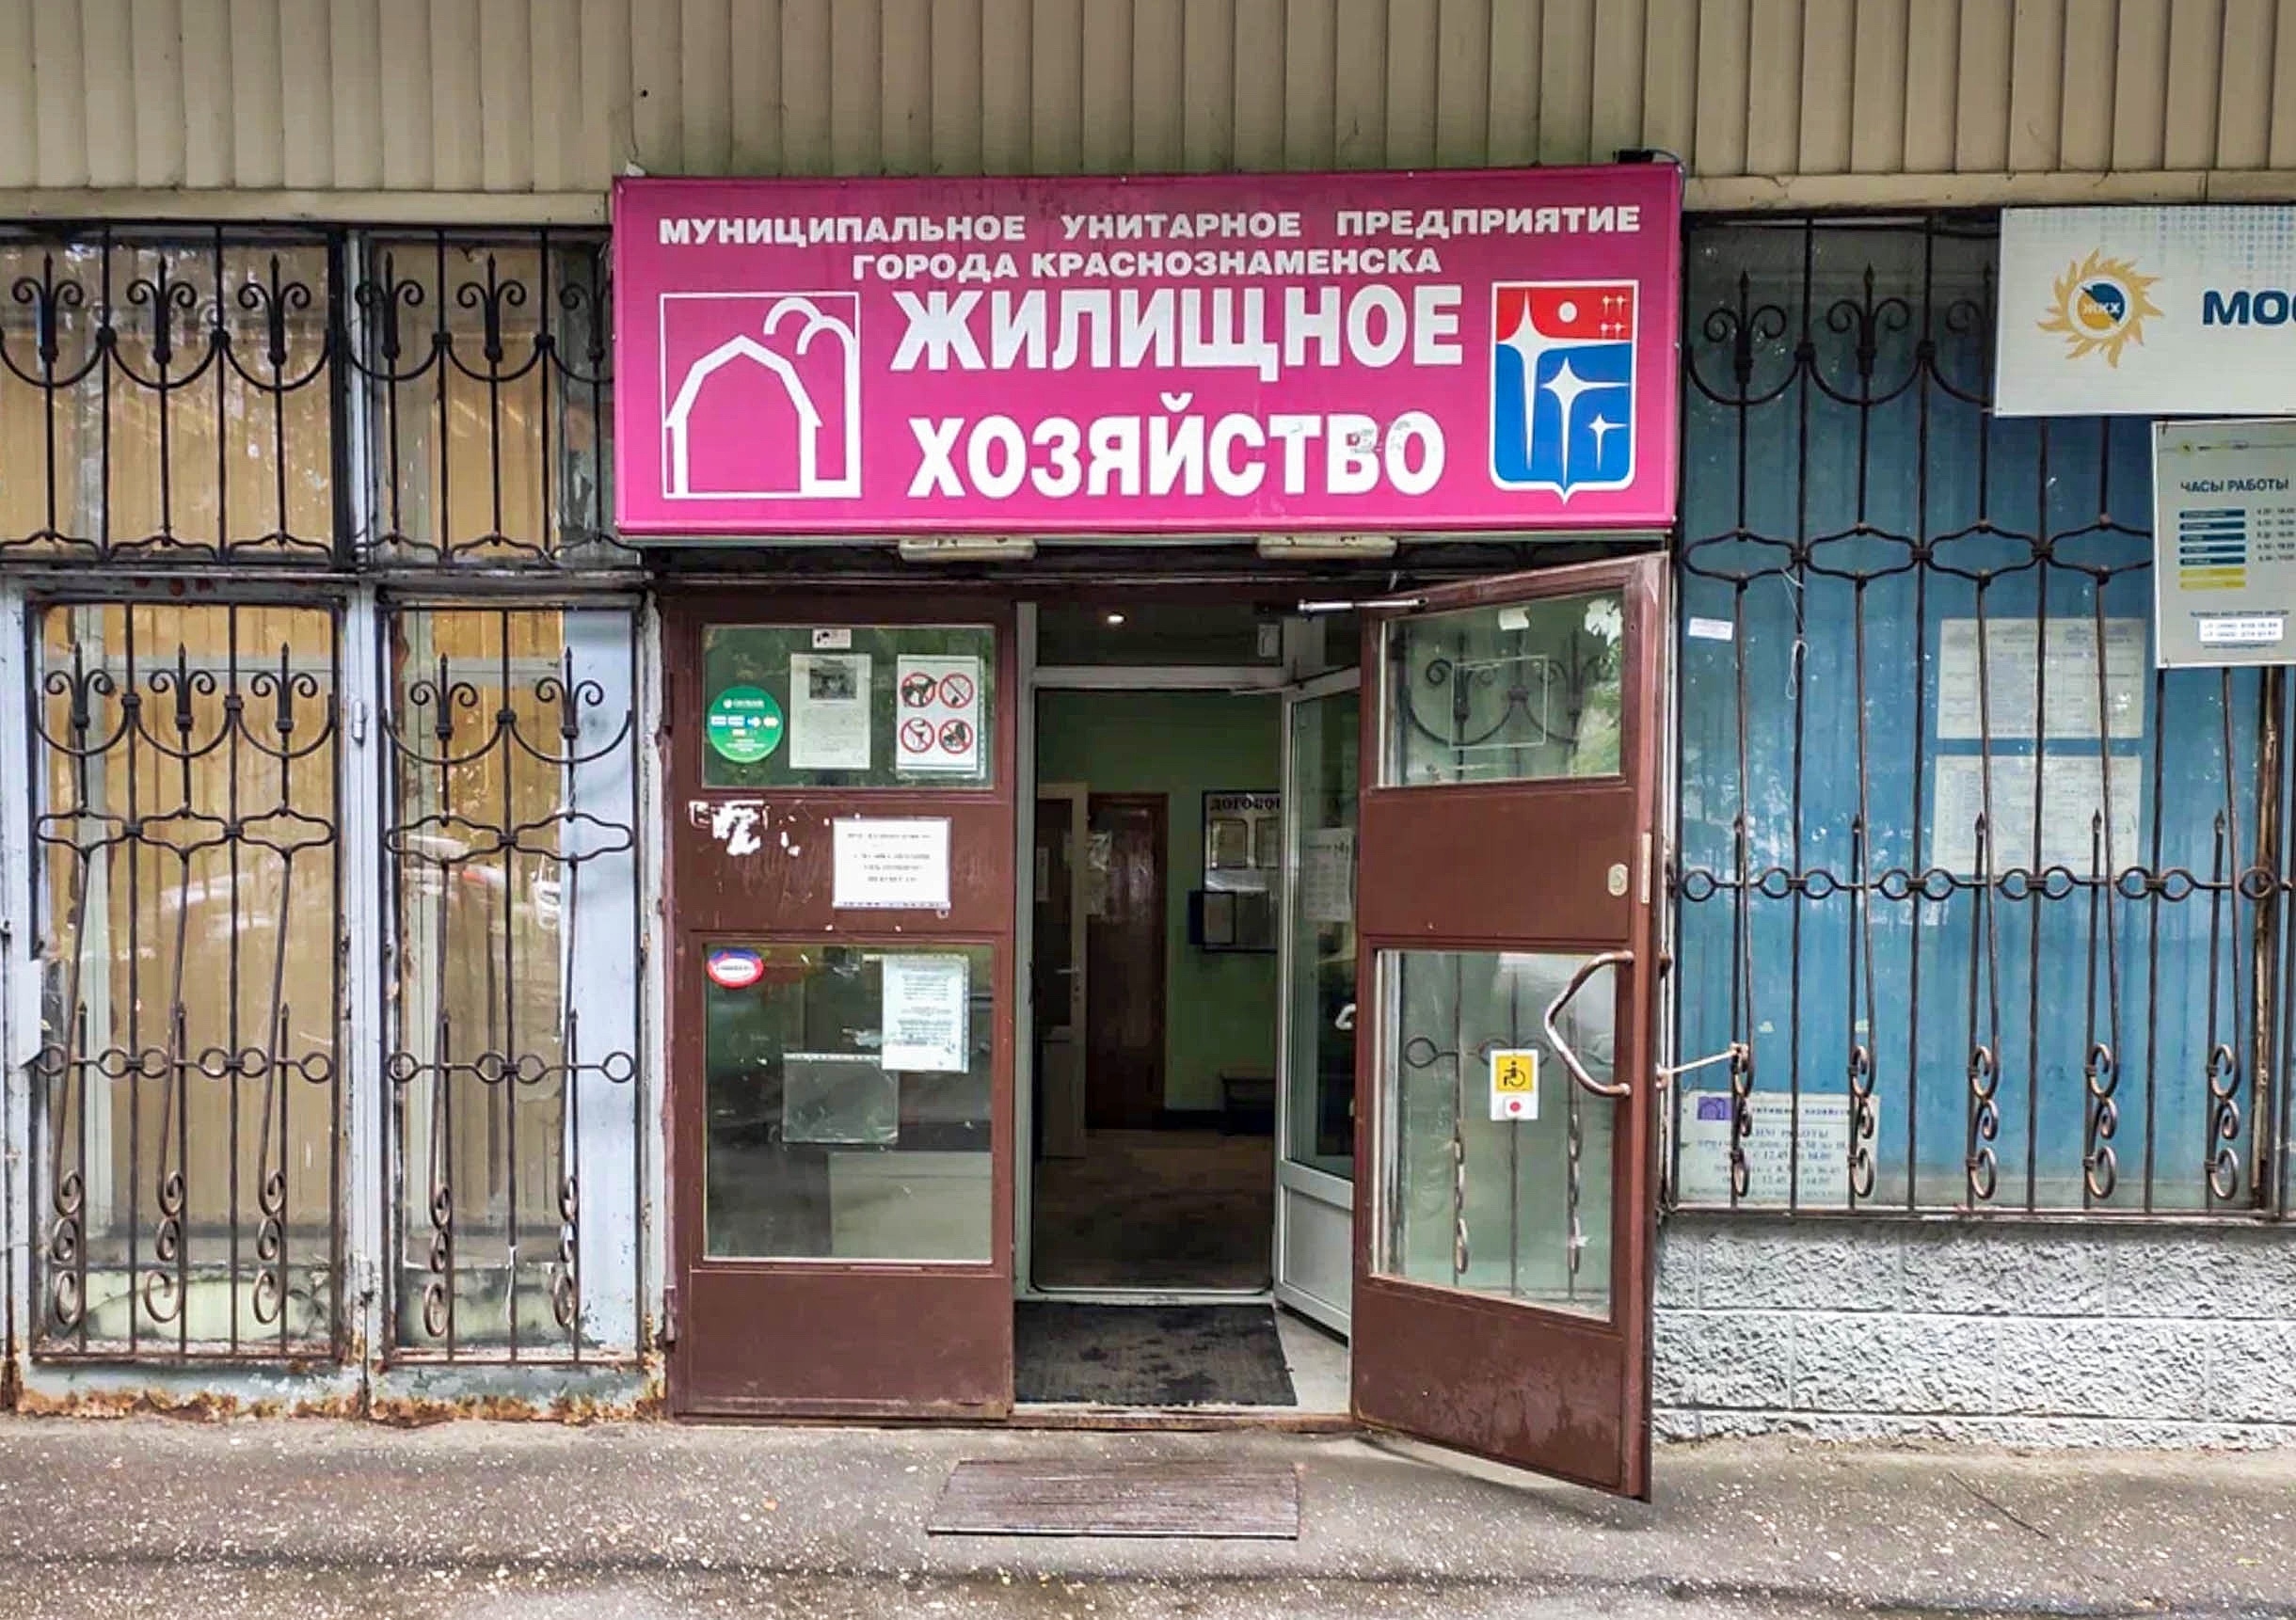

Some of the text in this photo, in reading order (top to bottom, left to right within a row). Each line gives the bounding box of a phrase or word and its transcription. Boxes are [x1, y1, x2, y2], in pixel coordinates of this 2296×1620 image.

[659, 206, 1640, 247] МУНИЦИПАЛЬНОЕ УНИТАРНОЕ ПРЕДПРИЯТИЕ
[853, 247, 1442, 283] ГОРОДА КРАСНОЗНАМЕНСКА
[2202, 290, 2296, 326] МО
[890, 284, 1463, 382] ЖИЛИЩНОЕ
[908, 392, 1445, 499] ХОЗЯЙСТВО
[2180, 477, 2289, 493] ЧАСЫ РАБОТЫ
